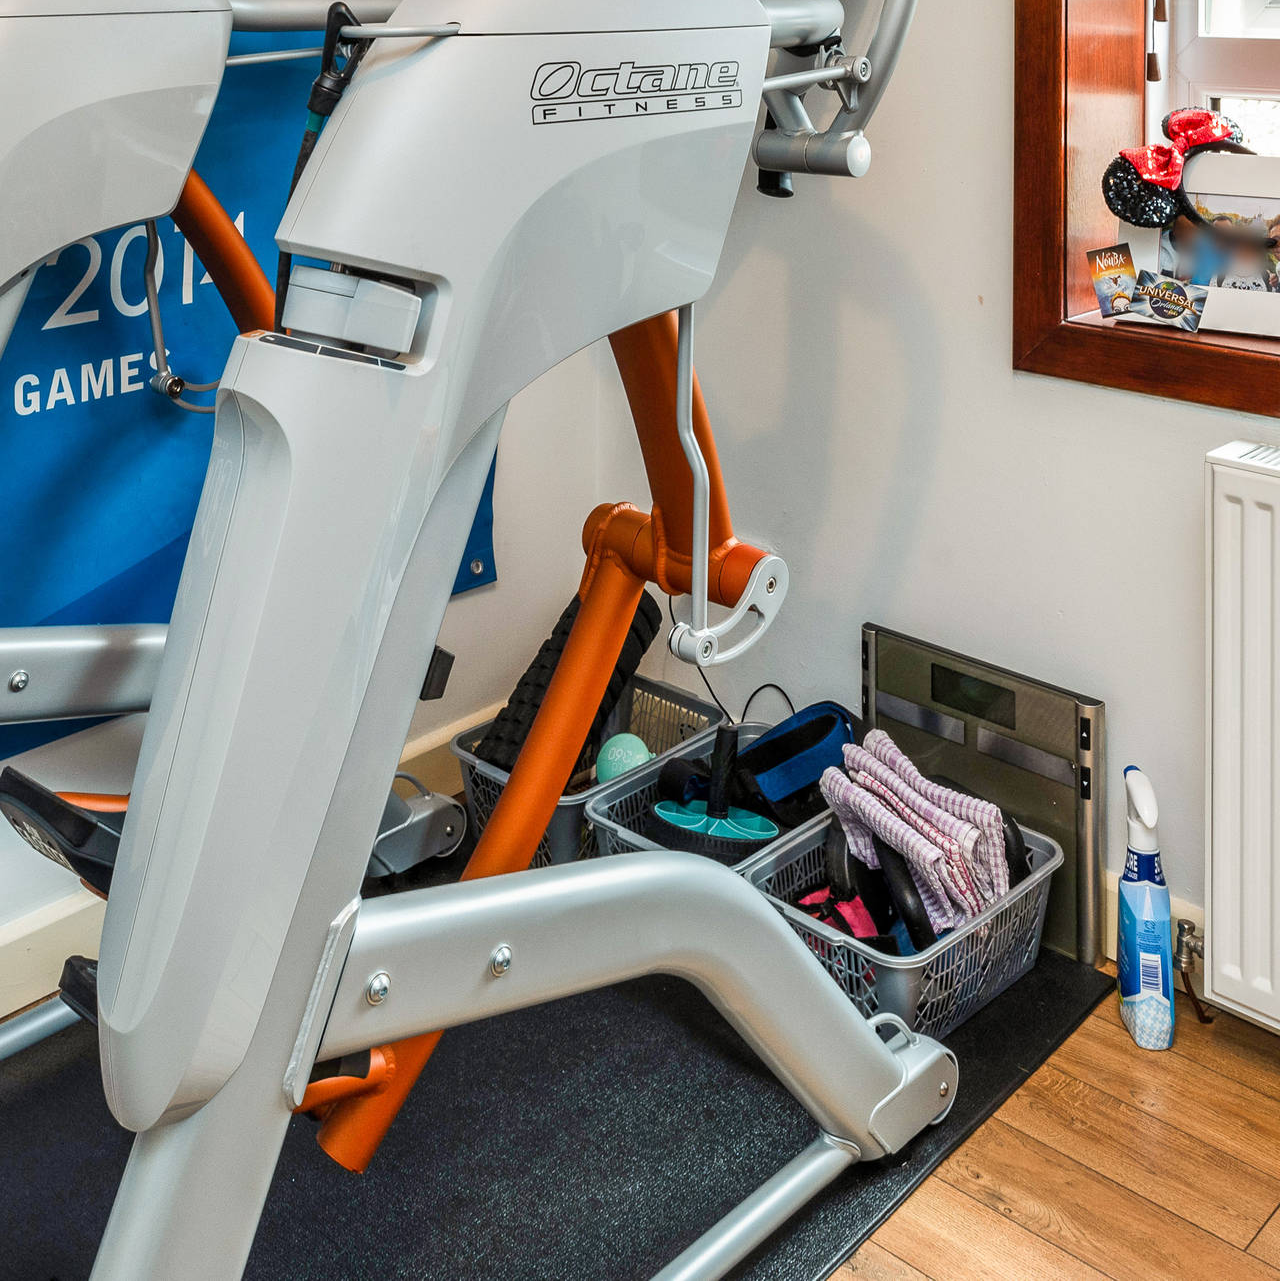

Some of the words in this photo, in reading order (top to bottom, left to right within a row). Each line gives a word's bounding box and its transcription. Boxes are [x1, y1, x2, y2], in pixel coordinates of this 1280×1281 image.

[530, 61, 739, 101] Octane
[542, 94, 733, 120] FITNESS
[1140, 286, 1196, 309] UNIVERSAL
